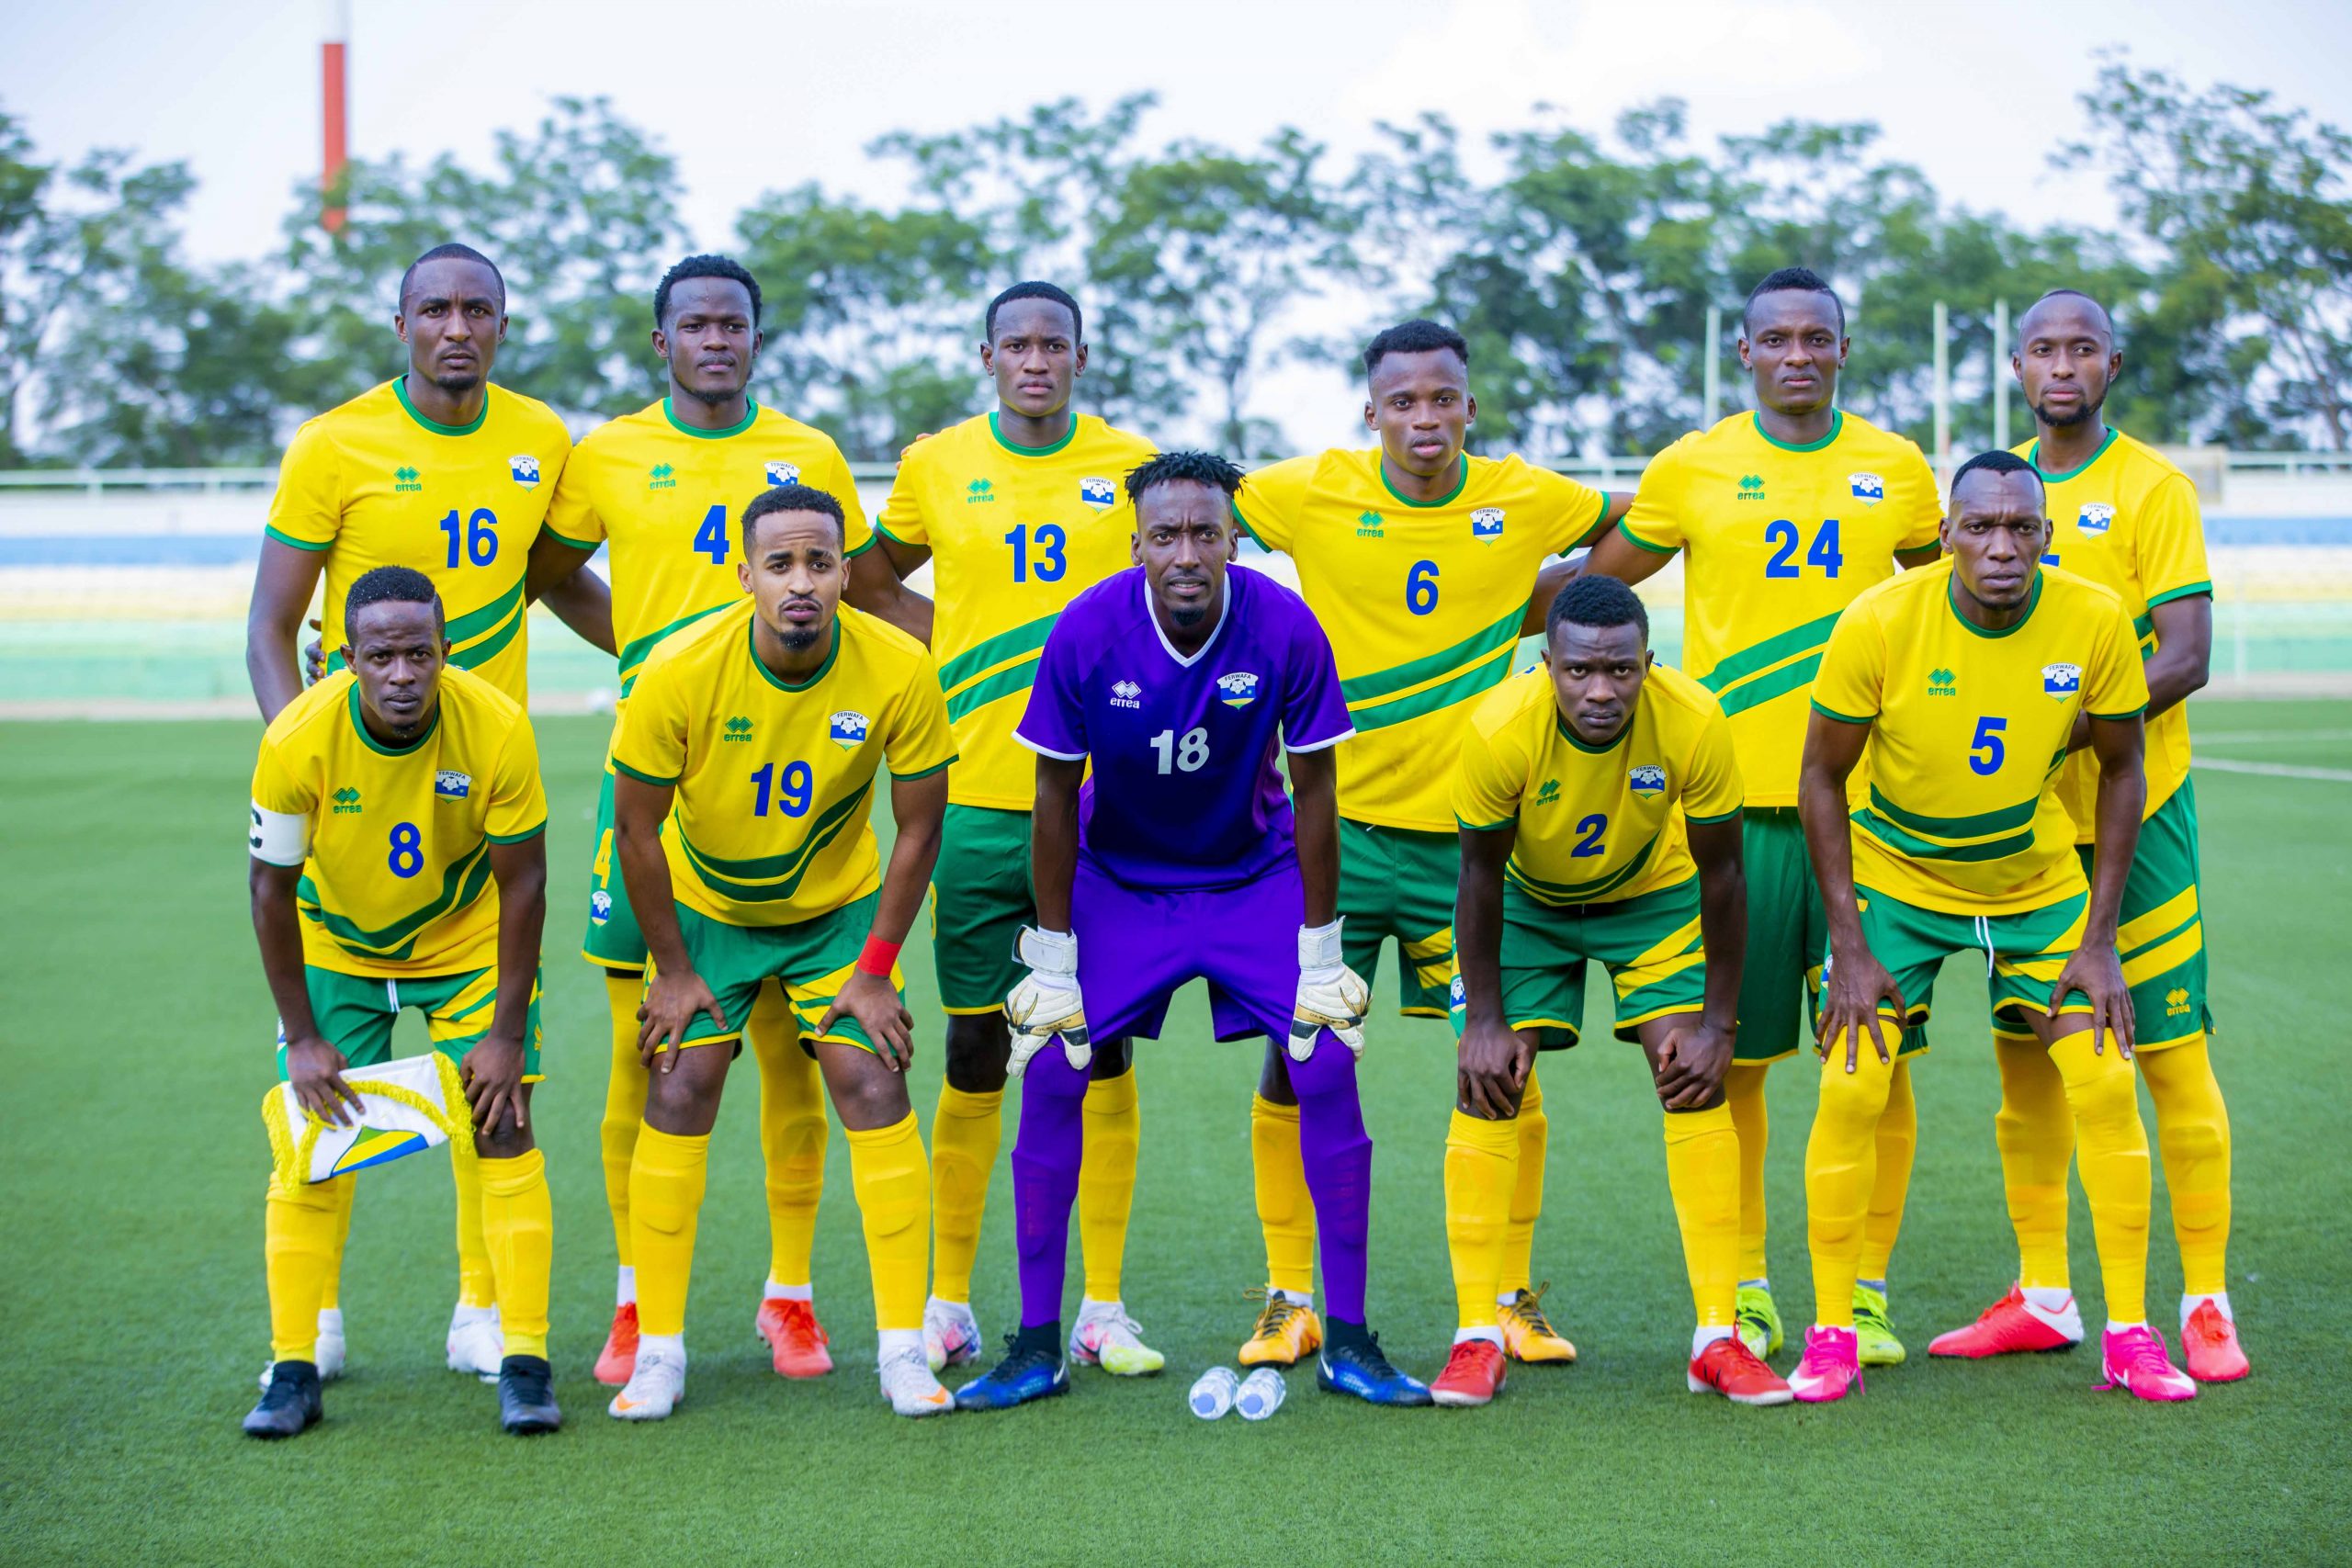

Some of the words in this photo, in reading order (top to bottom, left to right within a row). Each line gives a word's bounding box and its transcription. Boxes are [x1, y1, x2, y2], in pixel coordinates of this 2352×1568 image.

[770, 462, 795, 470] FERWAFA
[395, 483, 422, 491] errea
[650, 479, 676, 490] errea
[1086, 478, 1111, 486] FERWAFA
[967, 494, 994, 504] errea
[439, 508, 499, 569] 16
[693, 504, 730, 565] 4
[1357, 528, 1384, 538] errea
[1004, 523, 1067, 583] 13
[1765, 519, 1843, 579] 24
[1406, 559, 1440, 616] 6
[2048, 663, 2075, 671] FERWAFA
[1224, 673, 1251, 682] FERWAFA
[1928, 686, 1956, 696] errea
[1110, 697, 1140, 709] errea
[837, 712, 864, 721] FERWAFA
[724, 734, 752, 742] errea
[1149, 727, 1210, 774] 18
[1969, 716, 2007, 776] 5
[1635, 765, 1662, 773] FERWAFA
[438, 771, 466, 780] FERWAFA
[751, 760, 813, 818] 19
[1536, 793, 1560, 807] errea
[333, 805, 362, 814] errea
[1571, 814, 1607, 857] 2
[388, 822, 424, 879] 8
[593, 828, 615, 889] 4
